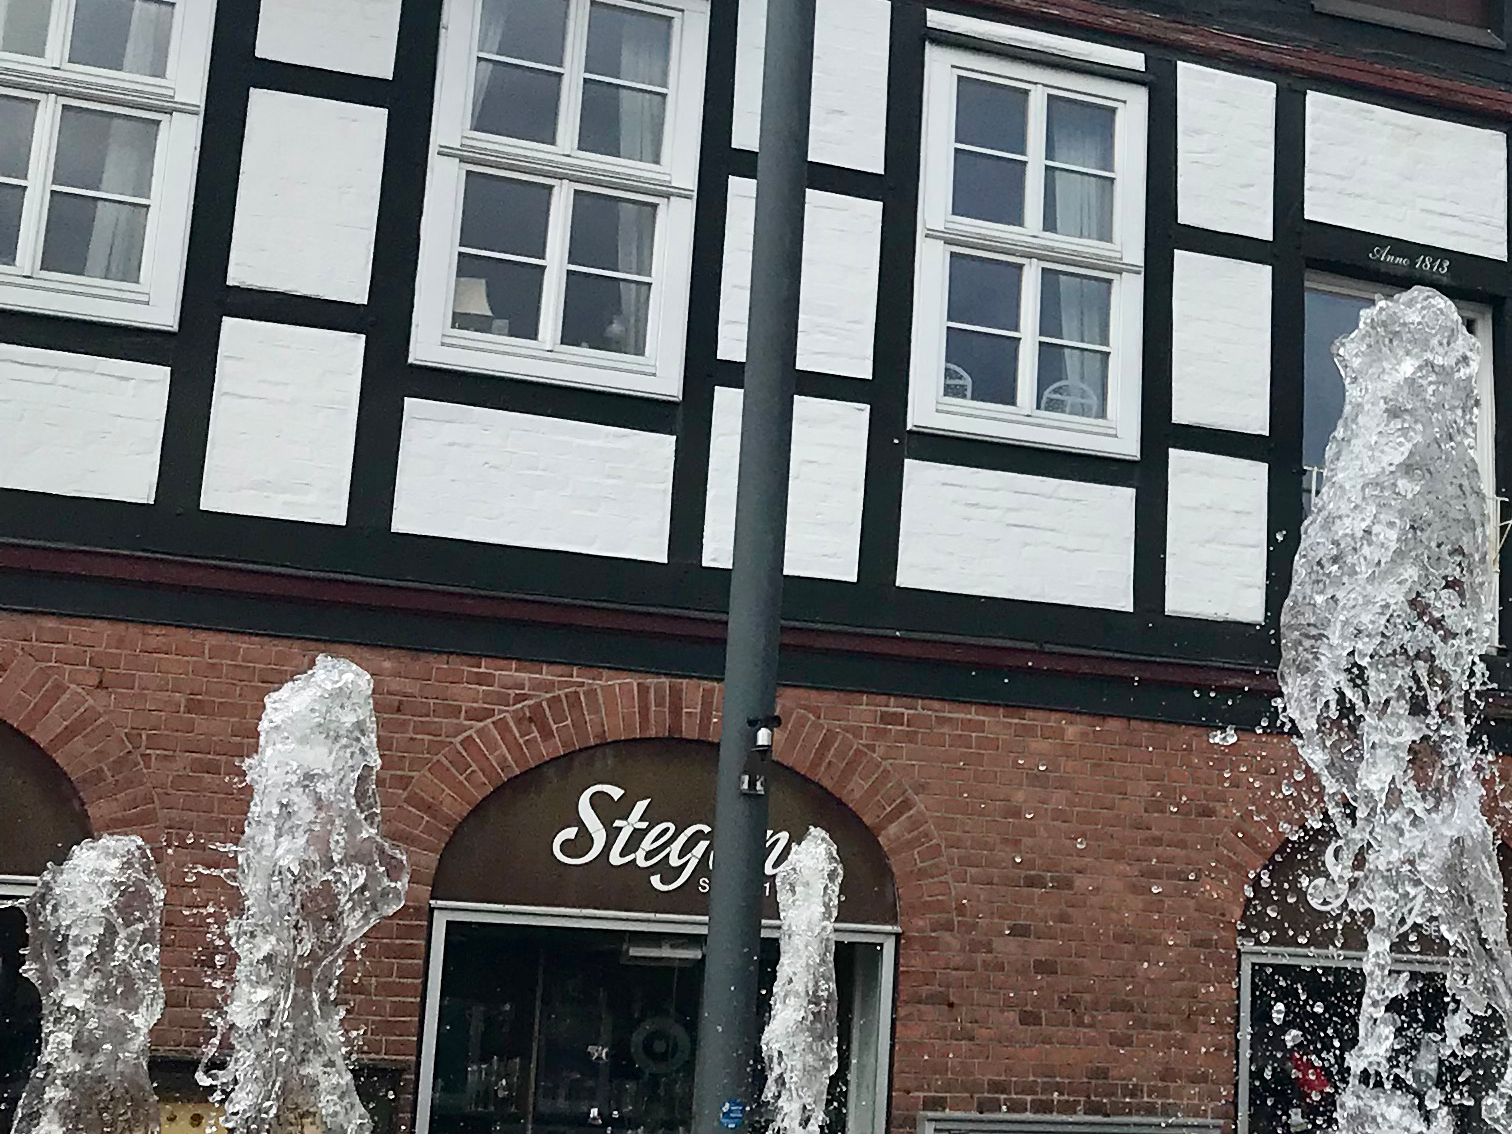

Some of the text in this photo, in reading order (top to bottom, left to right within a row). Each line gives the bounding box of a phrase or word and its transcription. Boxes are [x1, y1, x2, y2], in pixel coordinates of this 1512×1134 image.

[1368, 245, 1450, 274] Anno 1813
[552, 784, 791, 892] Stegn
